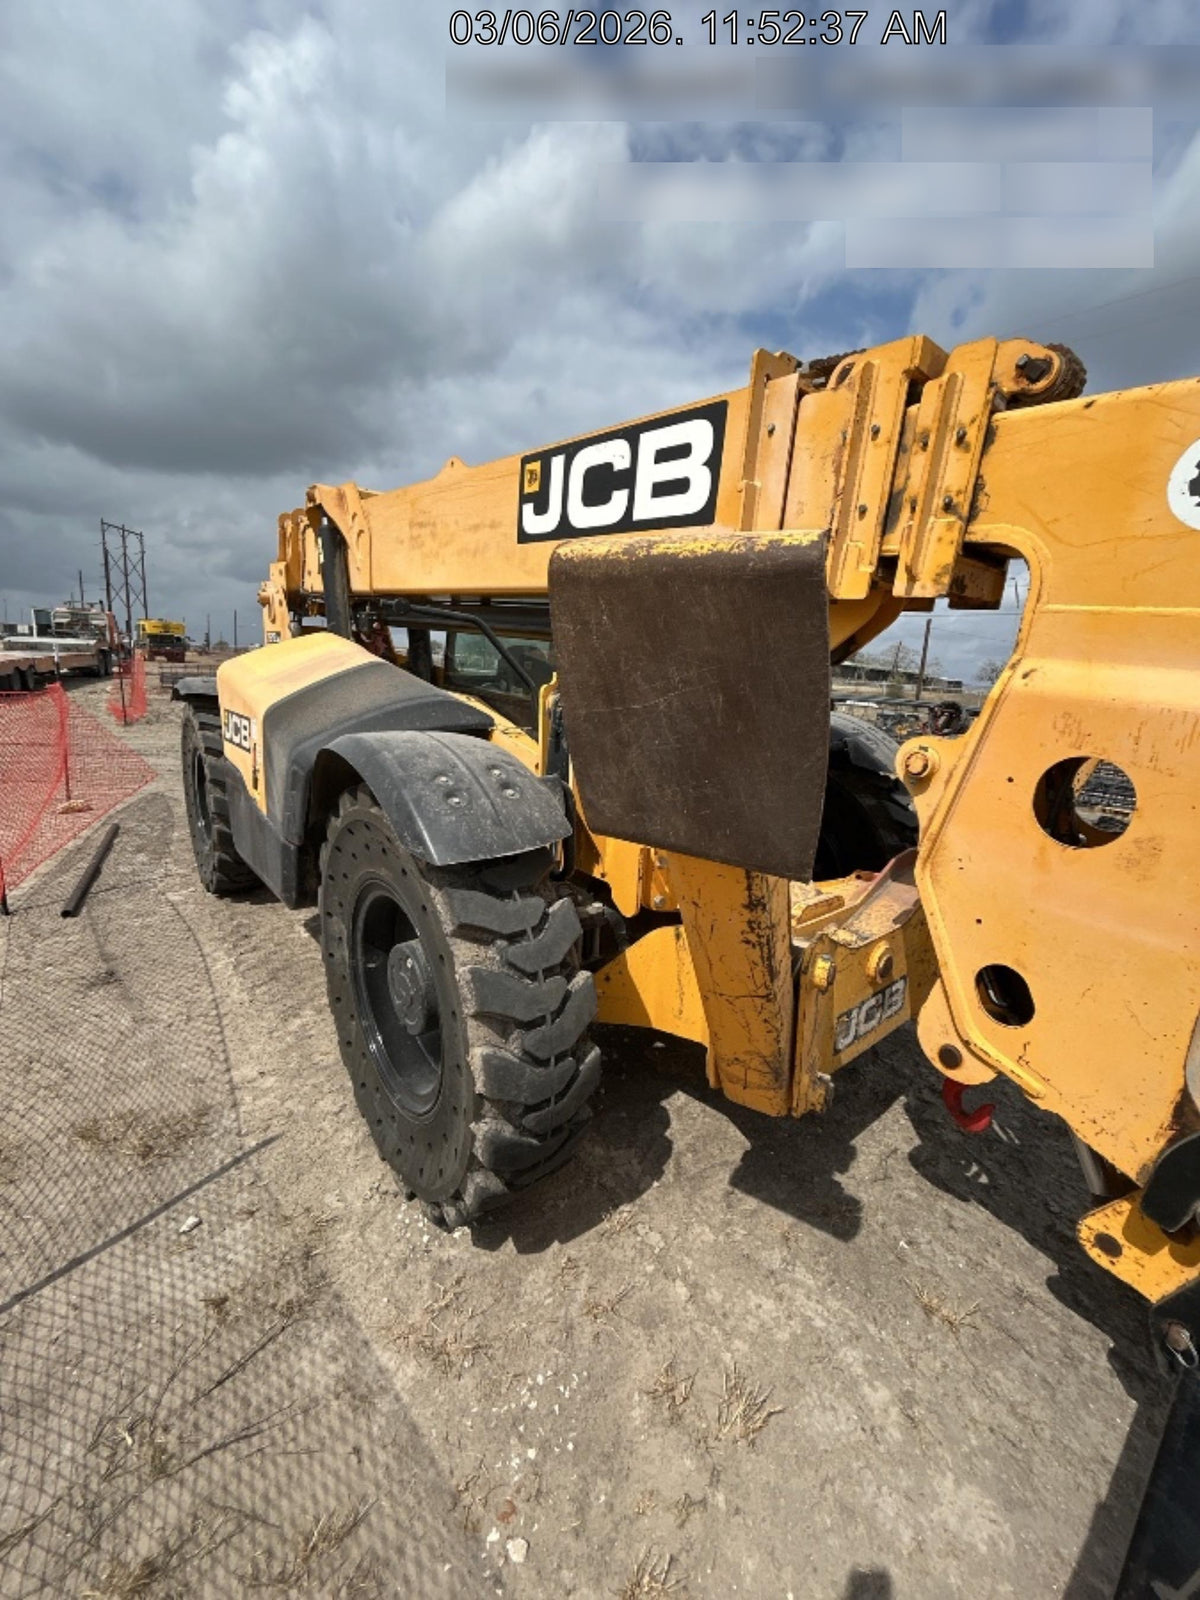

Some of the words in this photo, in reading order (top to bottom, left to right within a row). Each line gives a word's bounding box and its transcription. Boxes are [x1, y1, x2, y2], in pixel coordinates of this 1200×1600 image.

[522, 419, 714, 534] JCB
[225, 713, 250, 750] JCB
[835, 979, 905, 1050] JCB
